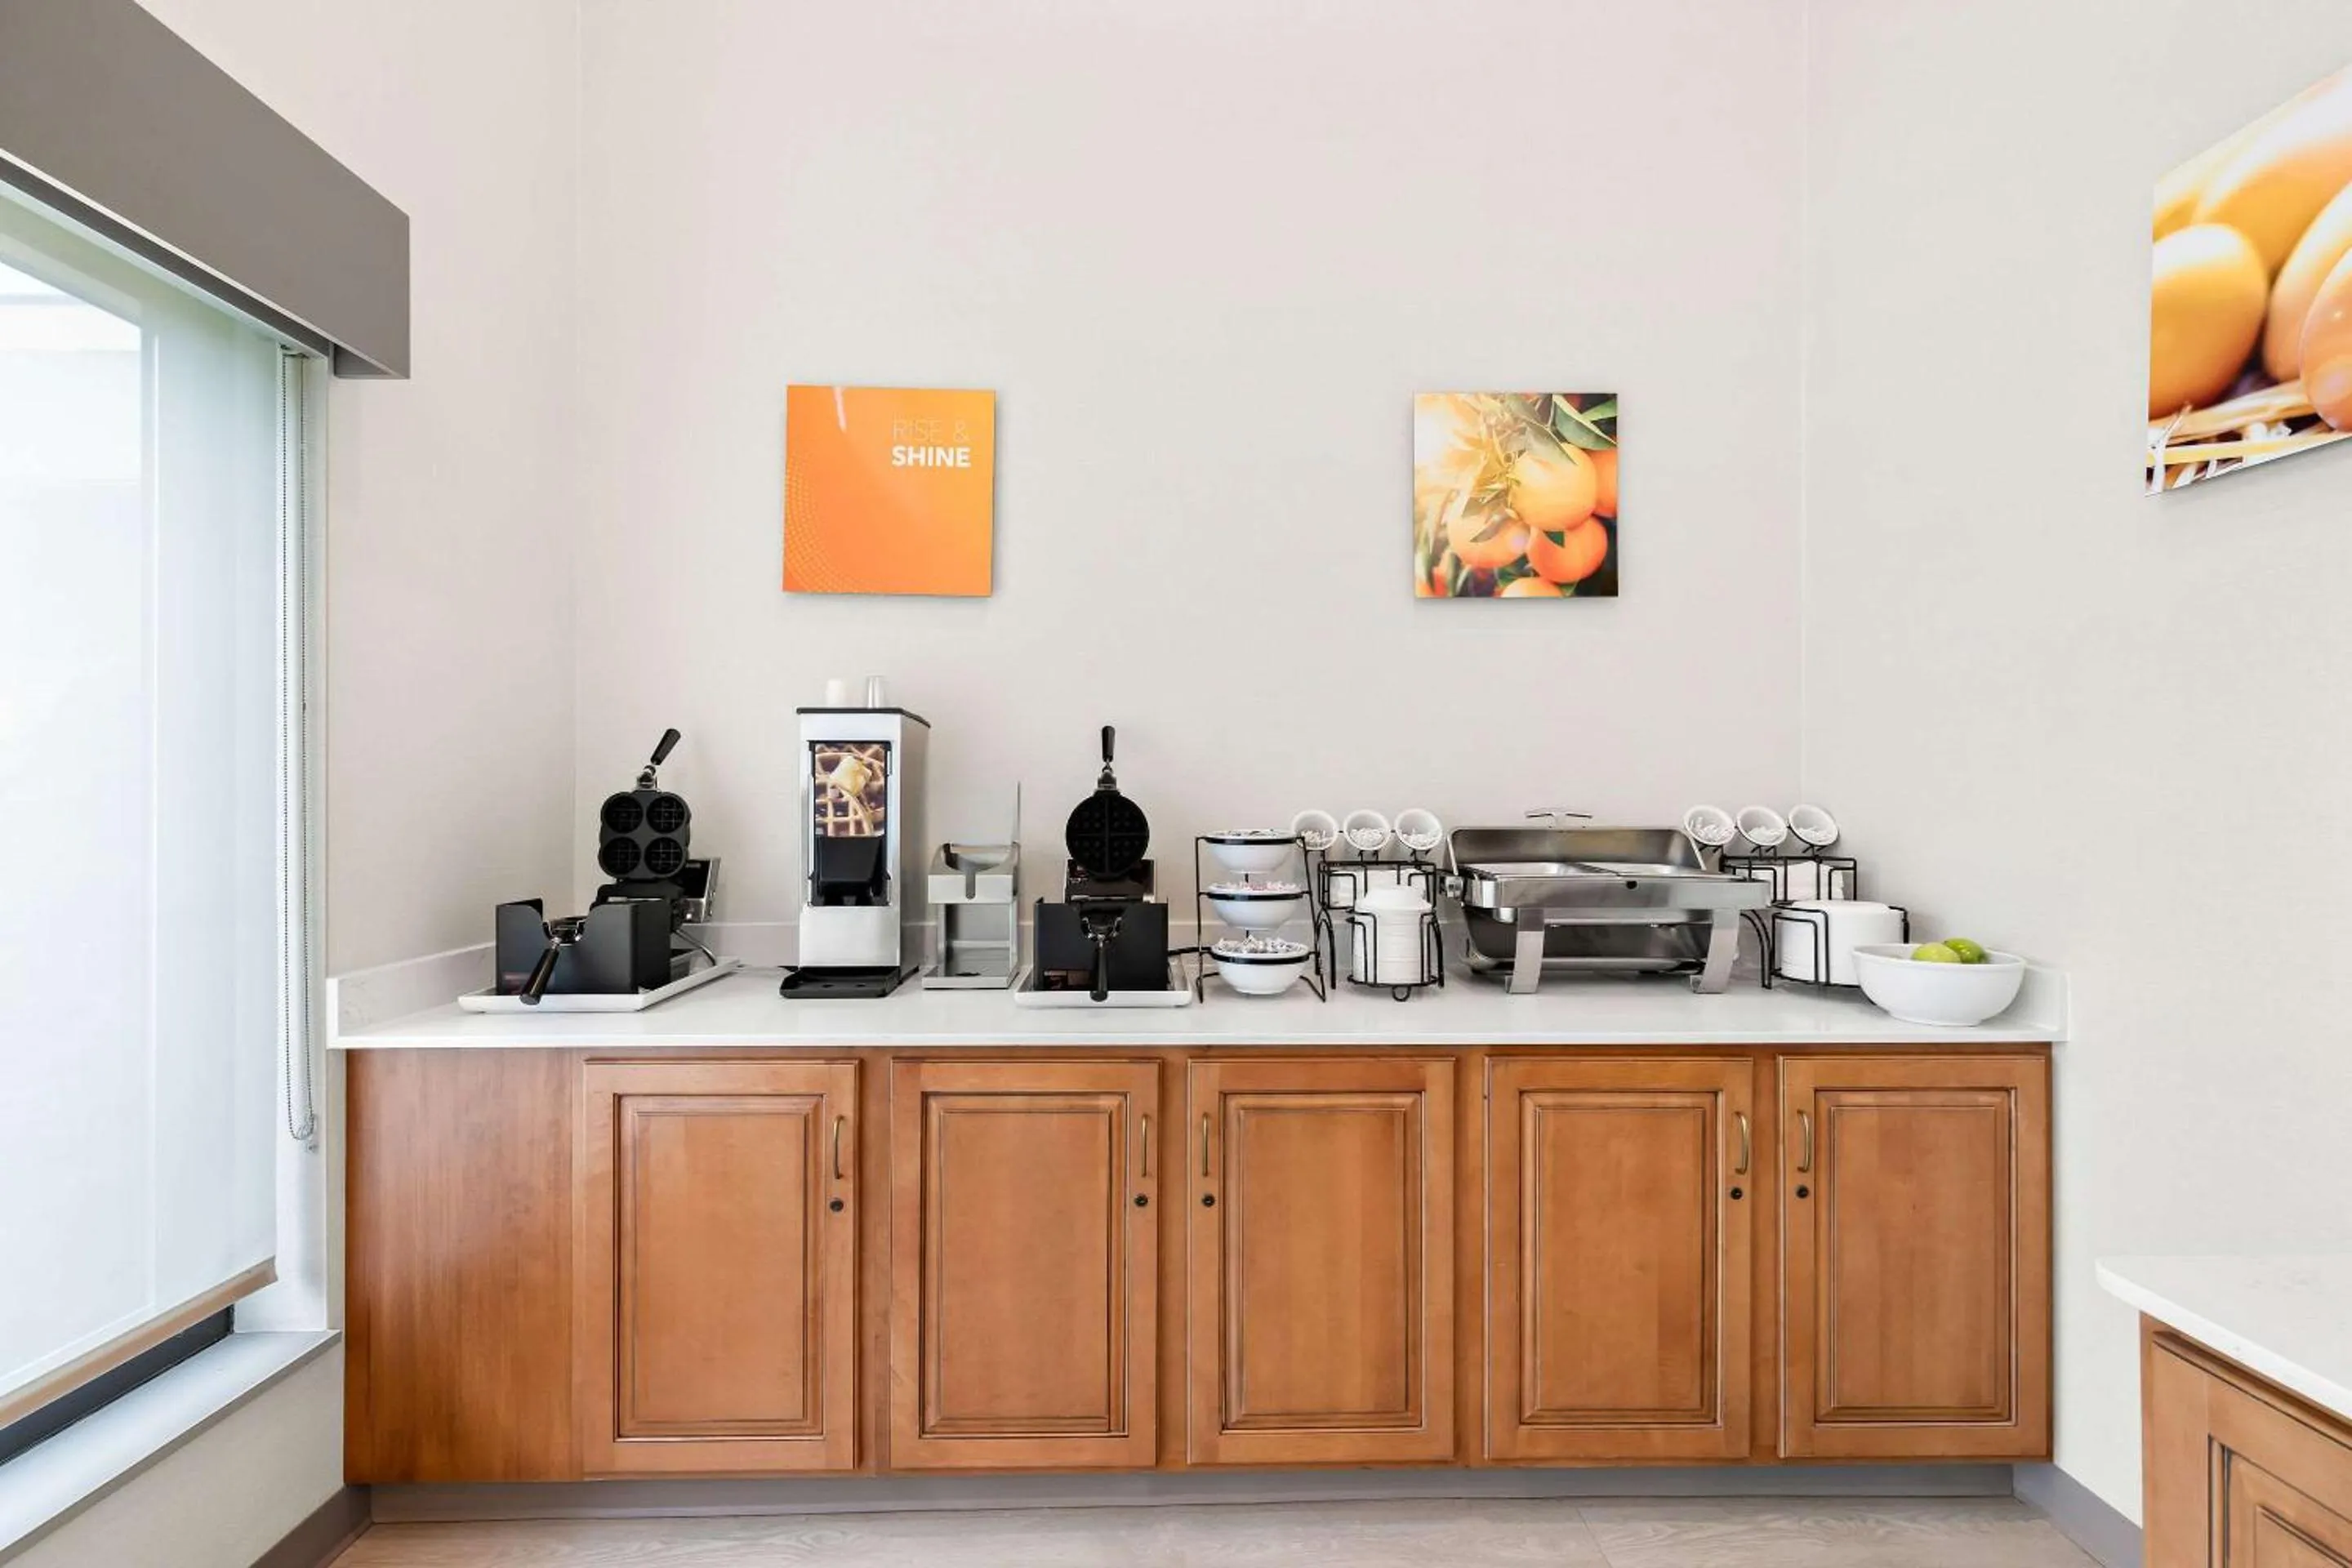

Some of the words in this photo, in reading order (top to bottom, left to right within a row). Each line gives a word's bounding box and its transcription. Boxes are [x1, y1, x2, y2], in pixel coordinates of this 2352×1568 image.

[893, 419, 943, 442] RISE
[953, 420, 970, 442] &
[892, 445, 971, 467] SHINE
